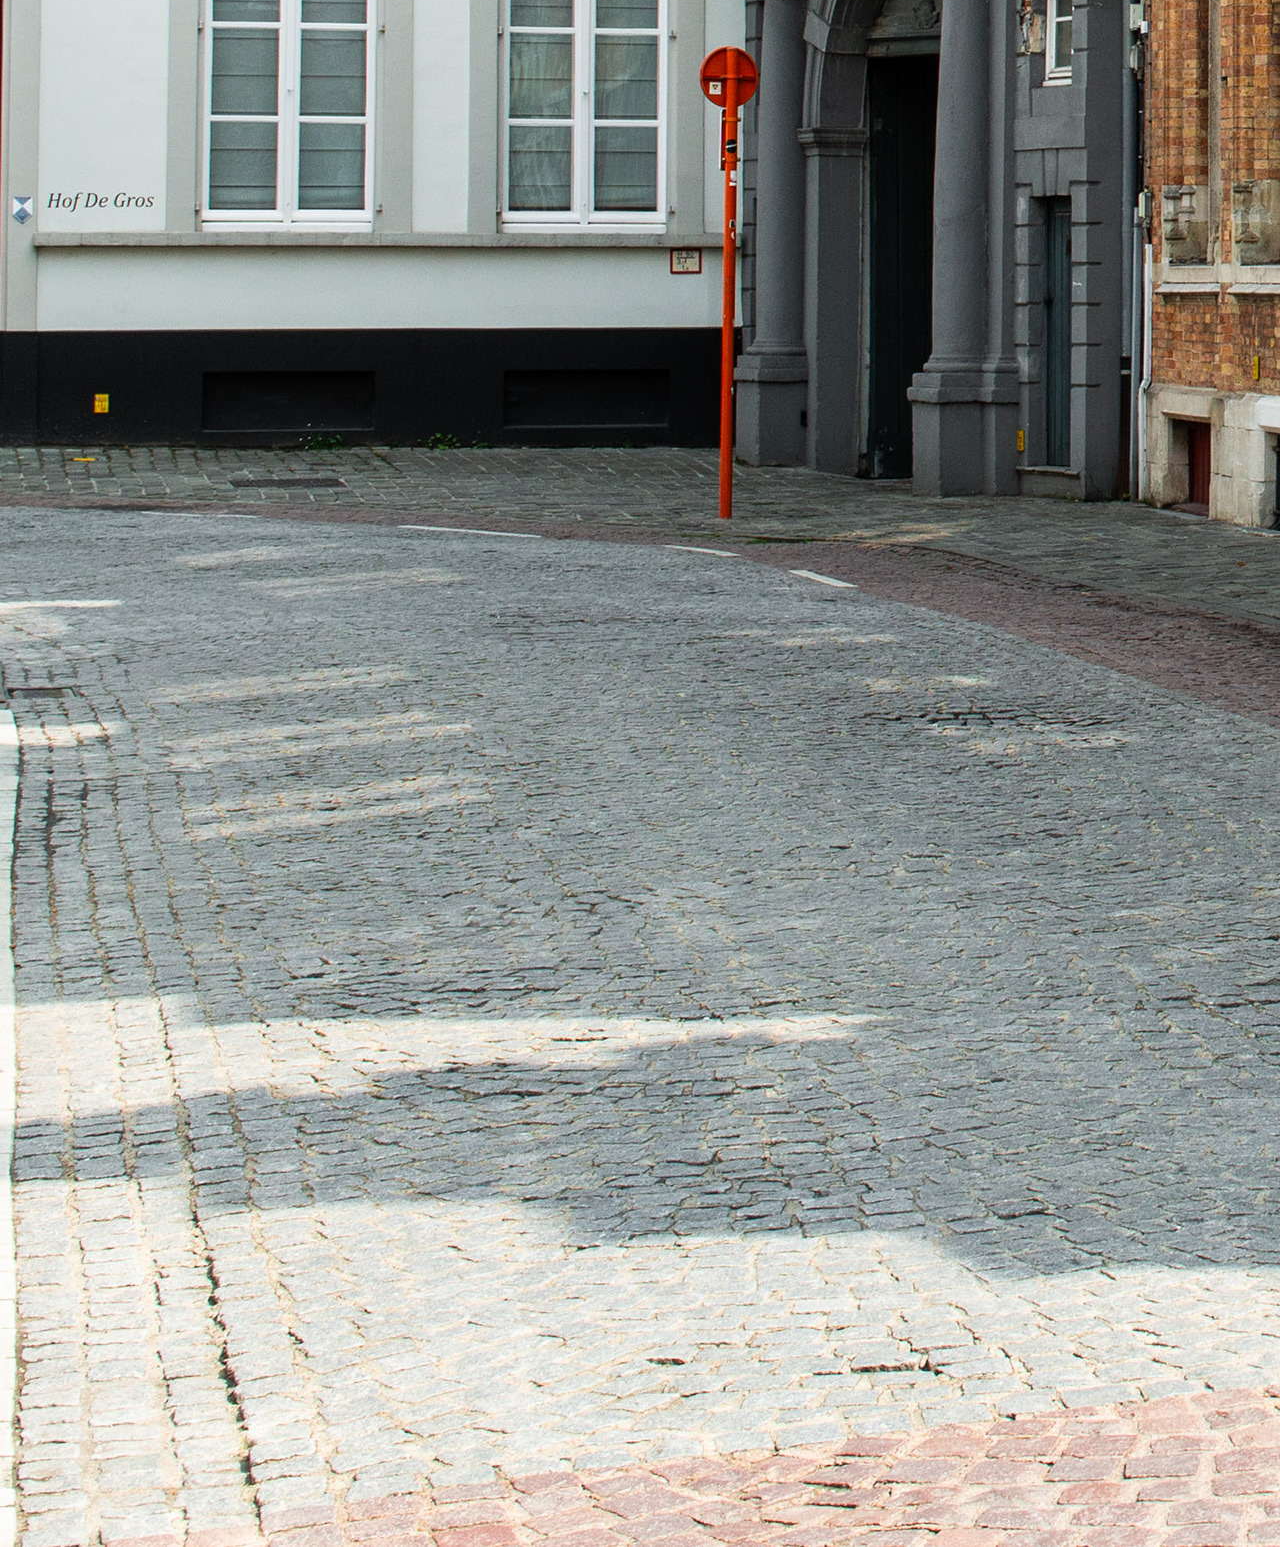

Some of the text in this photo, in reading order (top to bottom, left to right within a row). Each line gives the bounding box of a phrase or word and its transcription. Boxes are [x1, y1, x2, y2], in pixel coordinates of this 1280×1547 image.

[48, 192, 154, 212] Hof De Gros
